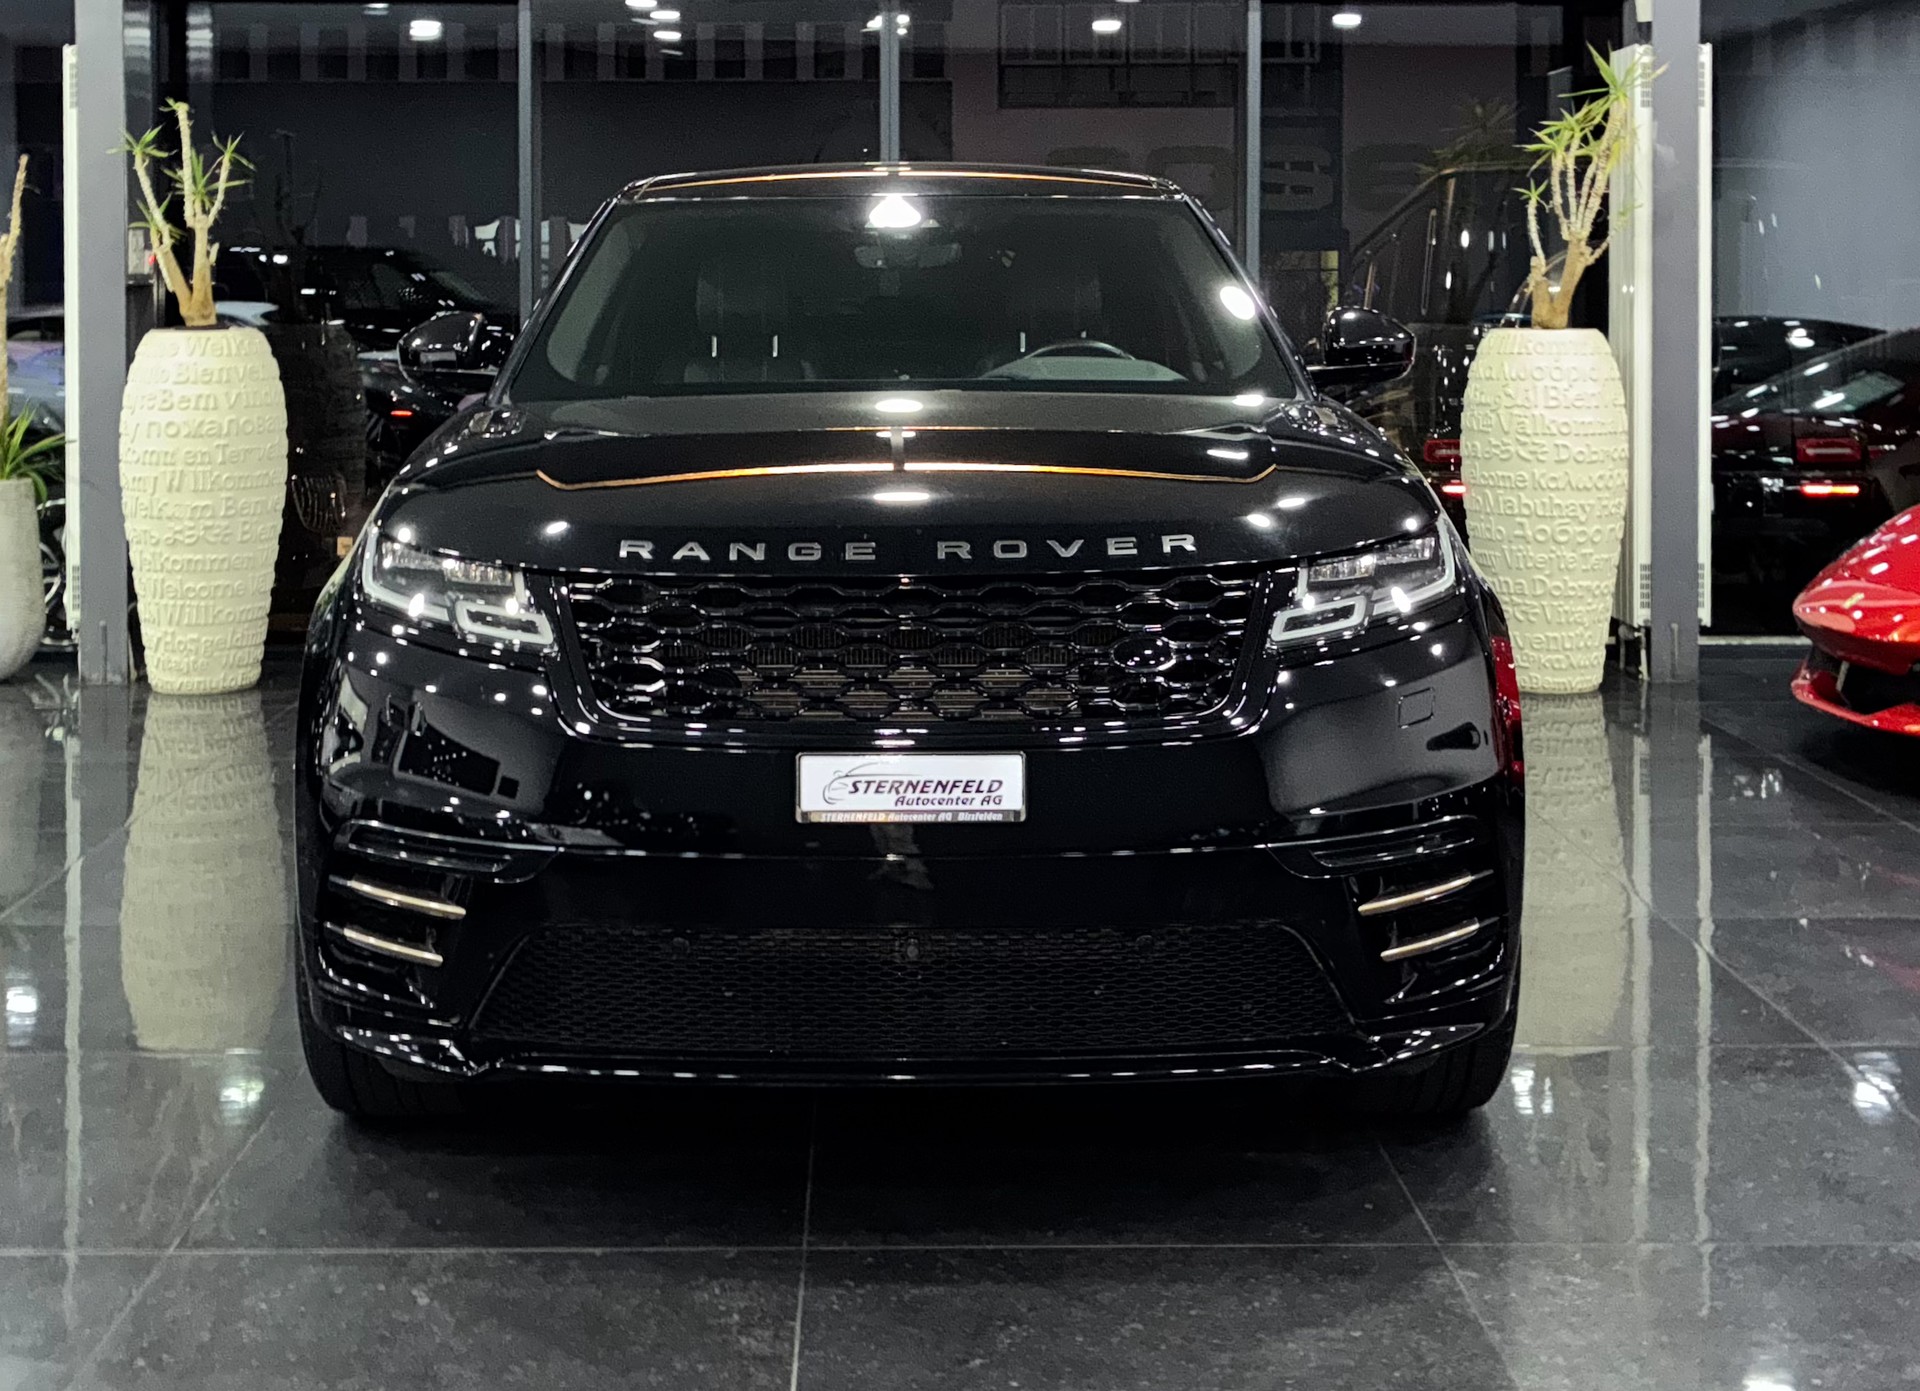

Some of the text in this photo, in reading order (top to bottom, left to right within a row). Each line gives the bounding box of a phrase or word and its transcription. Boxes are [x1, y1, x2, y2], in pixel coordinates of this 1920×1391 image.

[618, 533, 1197, 561] RANGE ROVER
[848, 779, 1004, 795] STERNENFELD
[894, 795, 1003, 807] Autocenter AG
[820, 811, 886, 822] STERNENFELD
[887, 811, 936, 822] Autocenter
